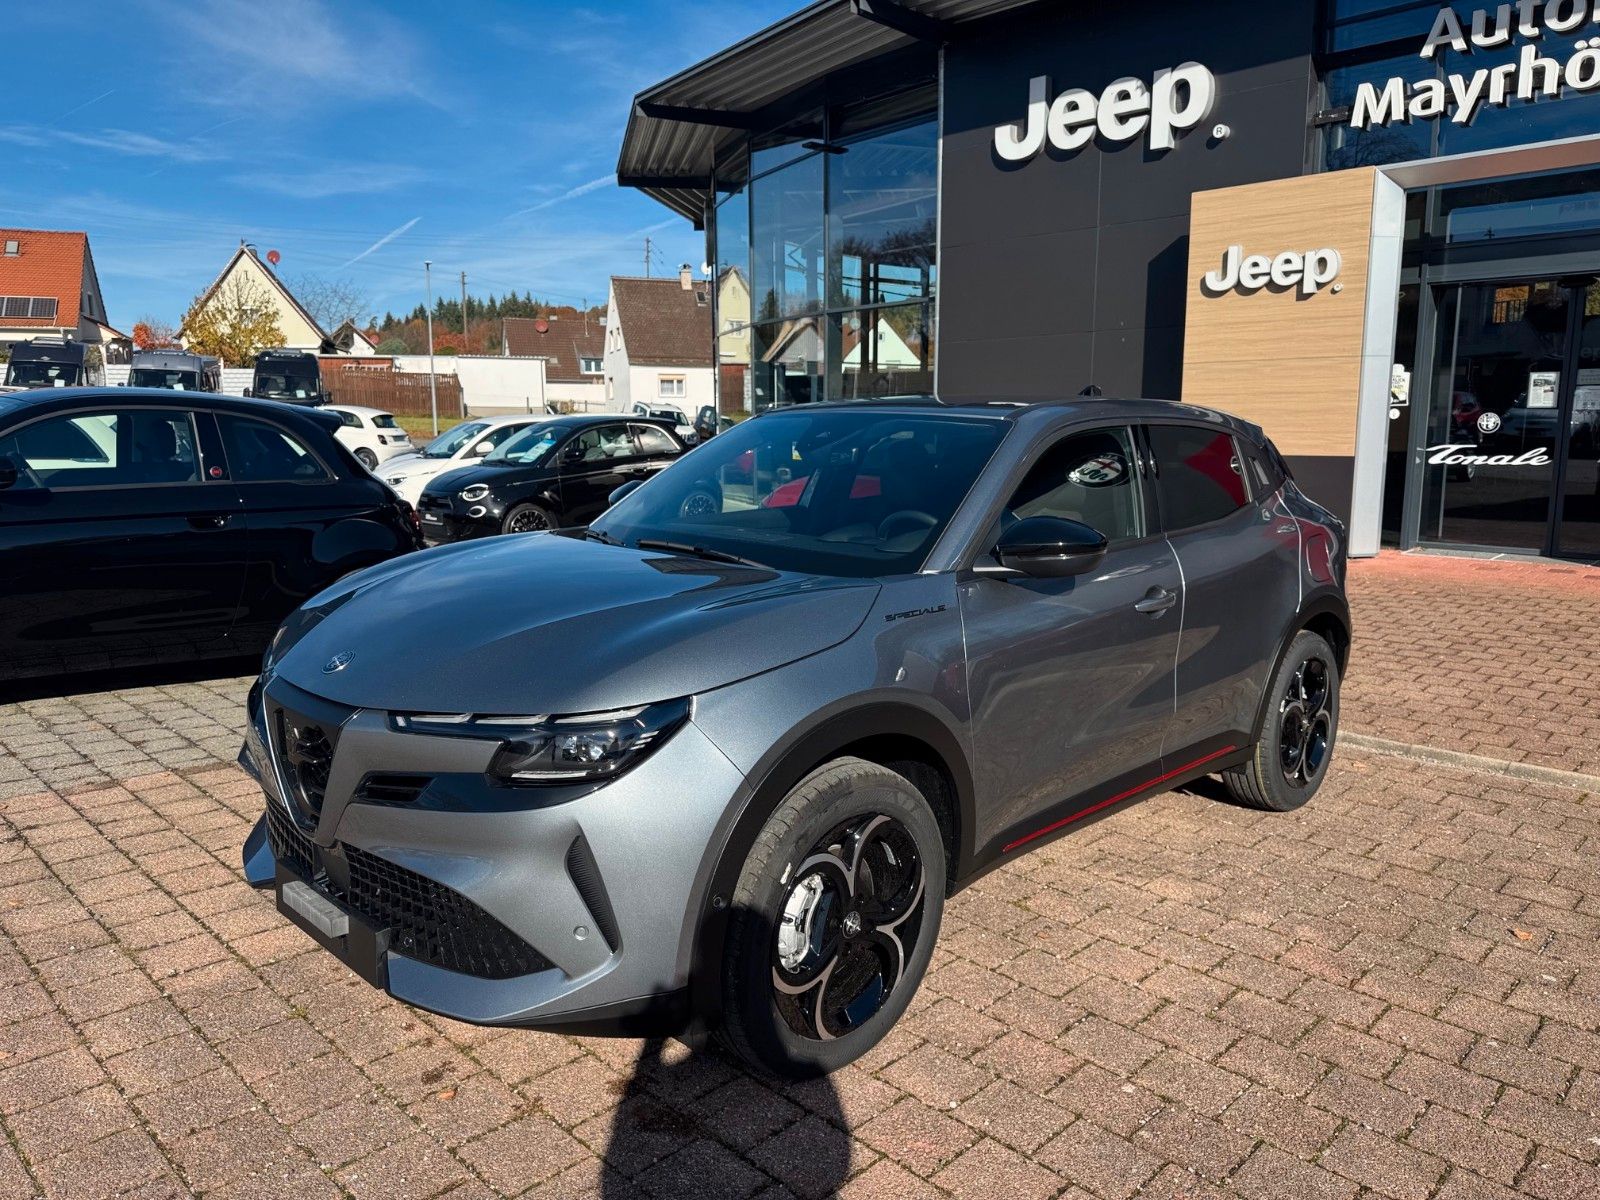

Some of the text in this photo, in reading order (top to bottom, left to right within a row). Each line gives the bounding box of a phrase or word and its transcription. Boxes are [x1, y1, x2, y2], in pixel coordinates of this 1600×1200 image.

[1419, 0, 1600, 58] Auto
[1350, 37, 1600, 127] Mayrhö
[994, 61, 1216, 160] Jeep
[1204, 245, 1341, 294] Jeep
[1426, 444, 1552, 466] Tonale
[884, 604, 947, 622] SPECIALE
